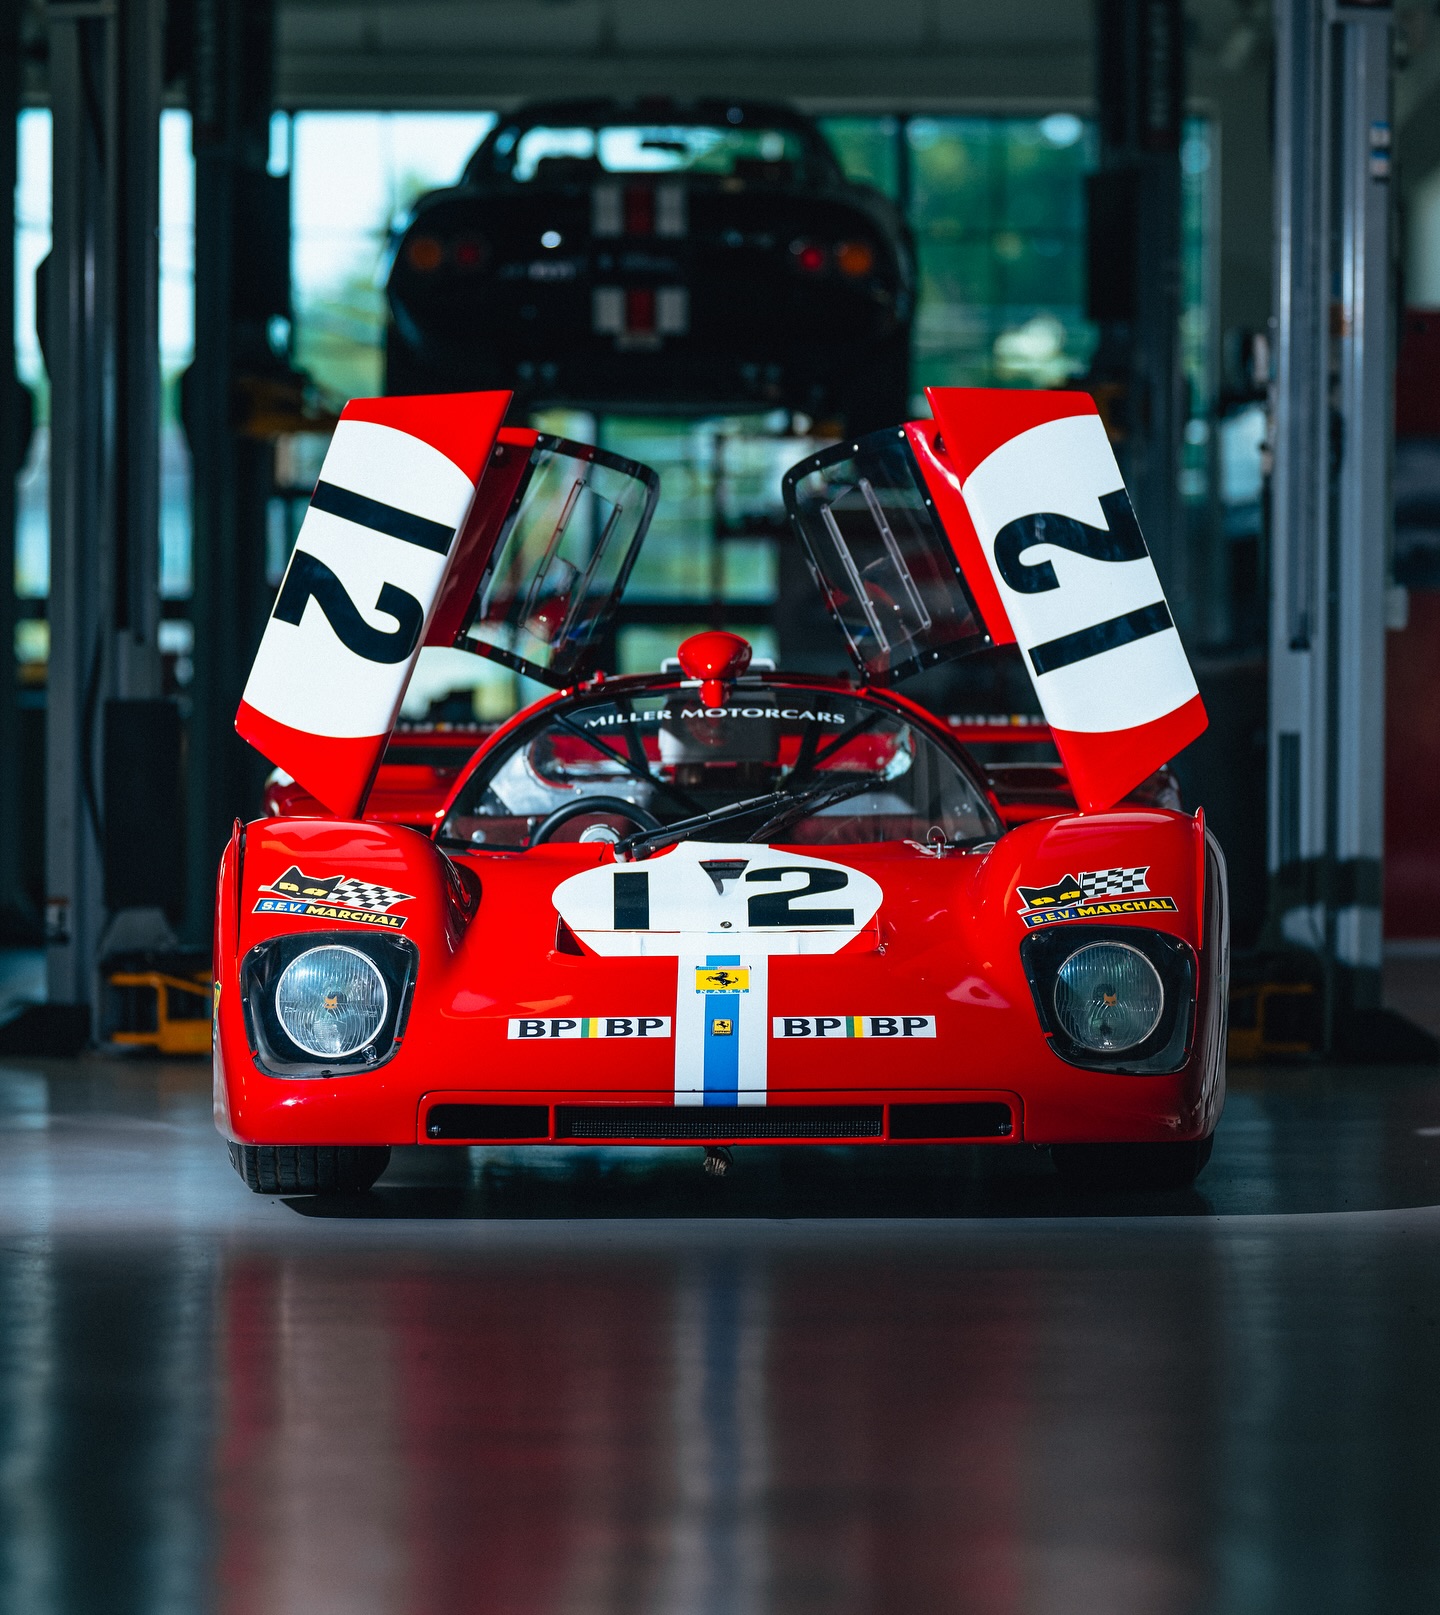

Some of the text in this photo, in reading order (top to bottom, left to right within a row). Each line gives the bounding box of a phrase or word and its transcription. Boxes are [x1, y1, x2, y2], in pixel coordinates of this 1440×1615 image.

[272, 479, 456, 664] 12
[993, 487, 1175, 677] 12
[584, 707, 846, 728] MILLER MOTORCARS
[613, 866, 855, 930] 12
[261, 901, 399, 927] S.E.V. MARCHAL
[1031, 899, 1173, 924] S.E.V. MARCHAL
[518, 1017, 664, 1038] BP BP
[783, 1016, 929, 1037] BP BP
